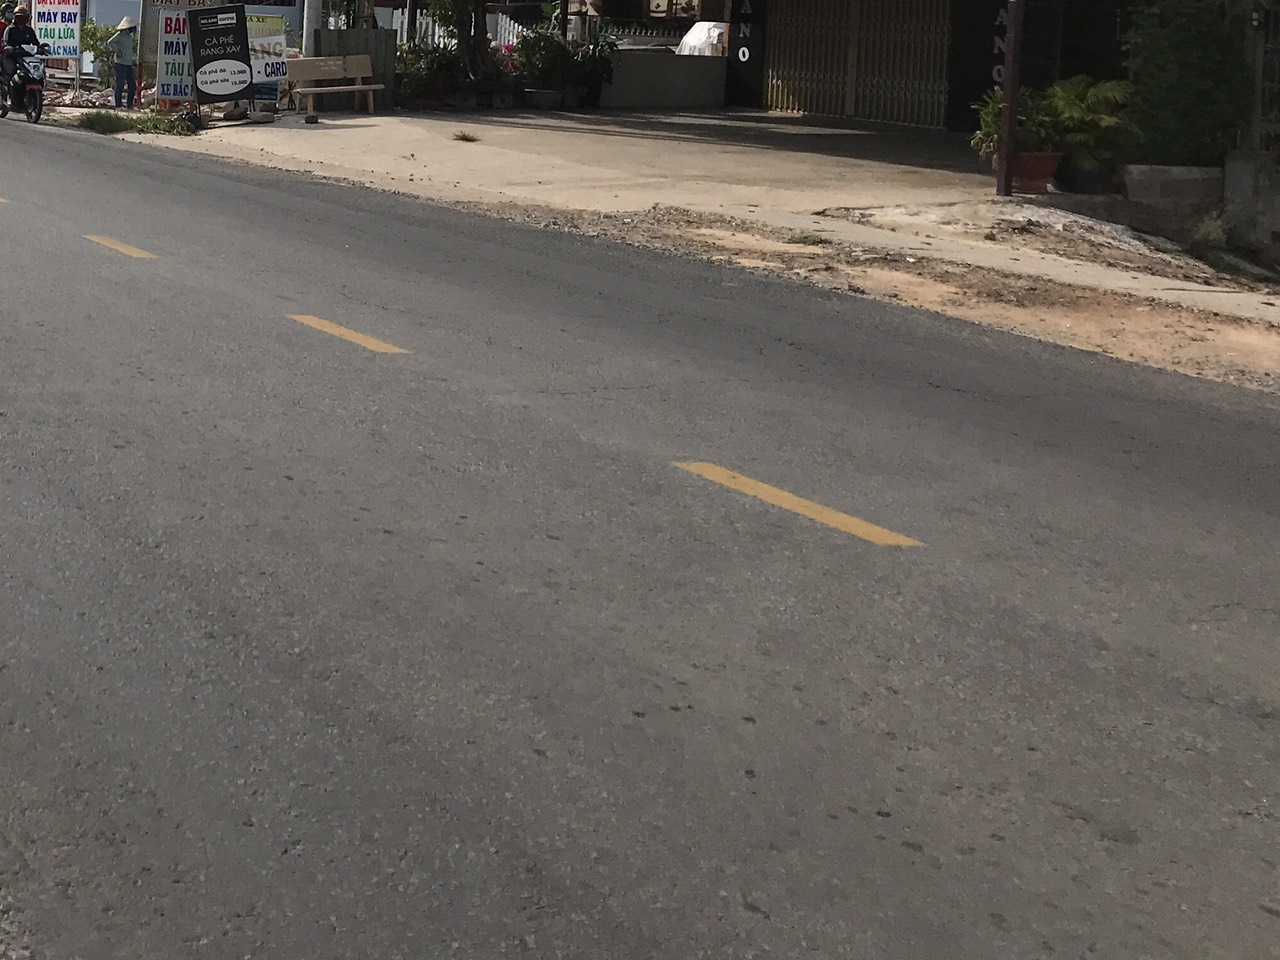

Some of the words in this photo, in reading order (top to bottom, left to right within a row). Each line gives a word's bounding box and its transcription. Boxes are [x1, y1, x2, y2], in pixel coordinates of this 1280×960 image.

[37, 9, 58, 23] MÁY
[61, 12, 78, 23] BAY
[38, 25, 55, 39] TÀU
[63, 46, 78, 56] NAM
[164, 38, 187, 55] MÁY
[200, 46, 224, 56] RANG
[226, 45, 241, 53] XAY
[164, 59, 184, 76] TÀU
[264, 61, 287, 78] CARD
[161, 83, 171, 95] XE
[173, 78, 189, 96] BẮC
